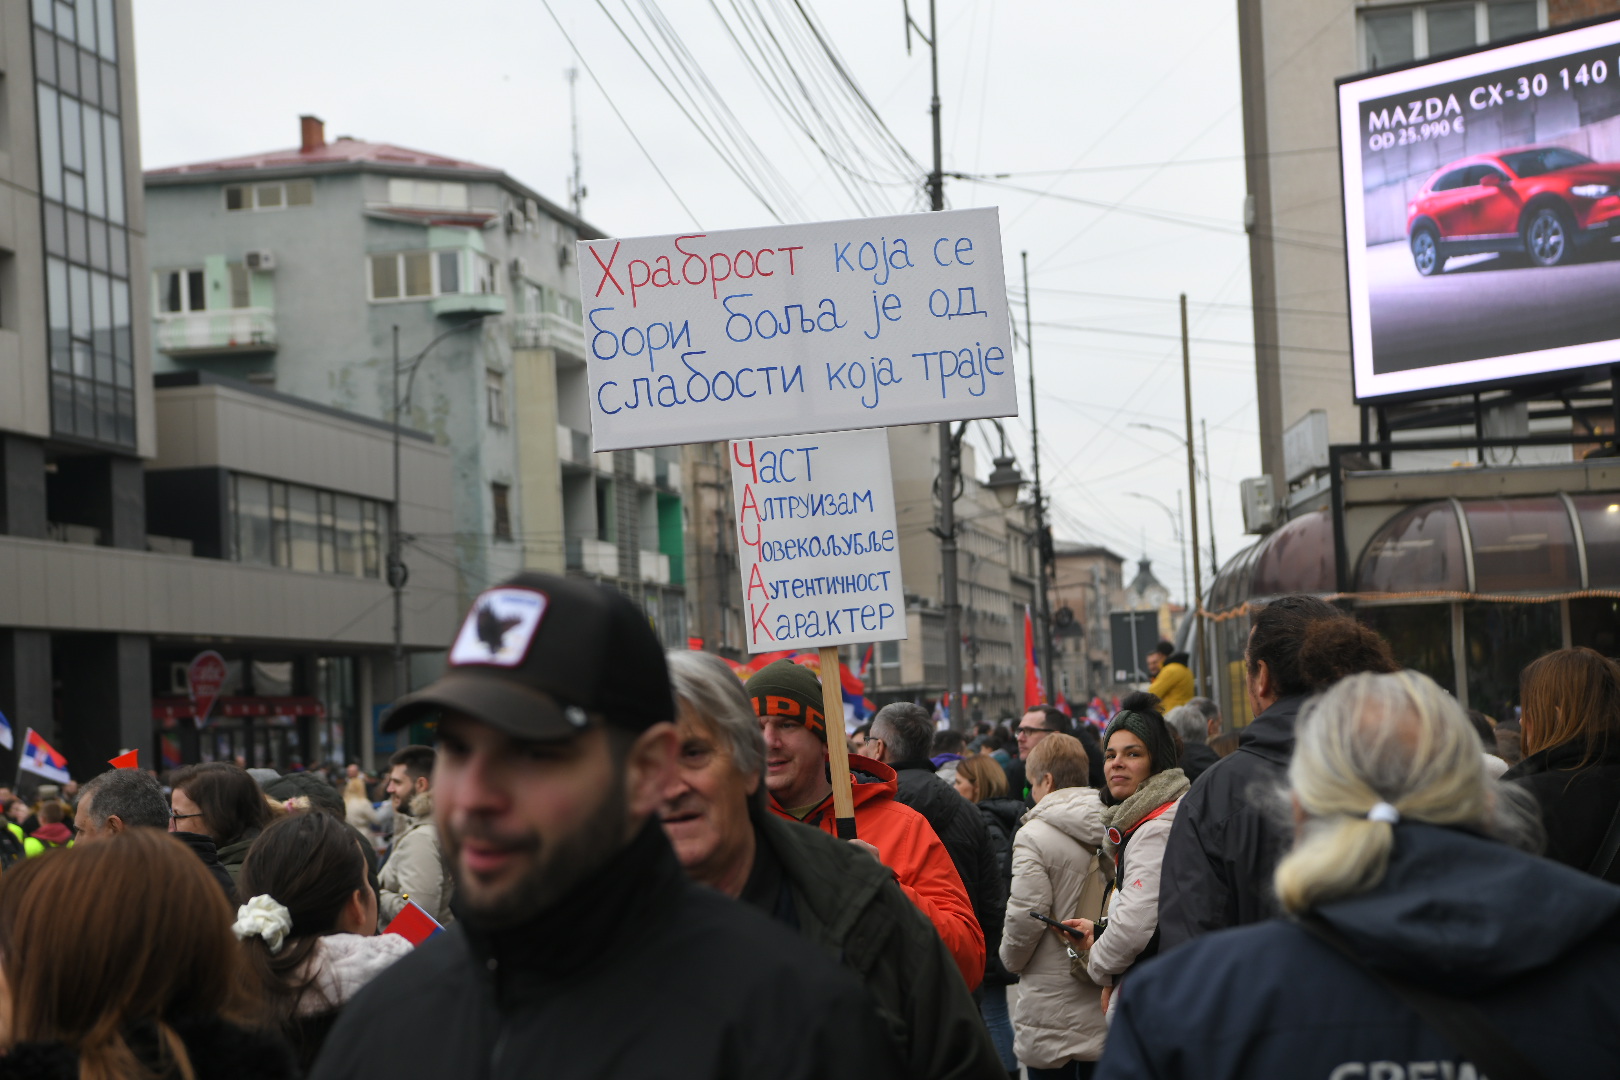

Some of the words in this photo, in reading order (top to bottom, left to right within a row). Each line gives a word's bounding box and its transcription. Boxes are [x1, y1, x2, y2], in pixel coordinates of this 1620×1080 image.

[1368, 93, 1461, 132] MAZDA
[1469, 73, 1548, 111] CX-30
[1559, 60, 1608, 91] 140
[1369, 131, 1395, 151] OD
[1398, 120, 1450, 145] 25.990
[1453, 116, 1465, 133] €
[589, 235, 803, 308] Храброст
[835, 237, 914, 285] која
[934, 238, 974, 266] се
[590, 308, 693, 371] бори
[723, 294, 847, 342] боља
[864, 290, 902, 339] је
[929, 287, 987, 319] од
[598, 351, 804, 414] слабости
[826, 357, 902, 408] која
[912, 342, 1005, 398] траје
[734, 441, 818, 484] Част
[748, 563, 890, 600] Аутентичност
[751, 603, 894, 644] Карактер
